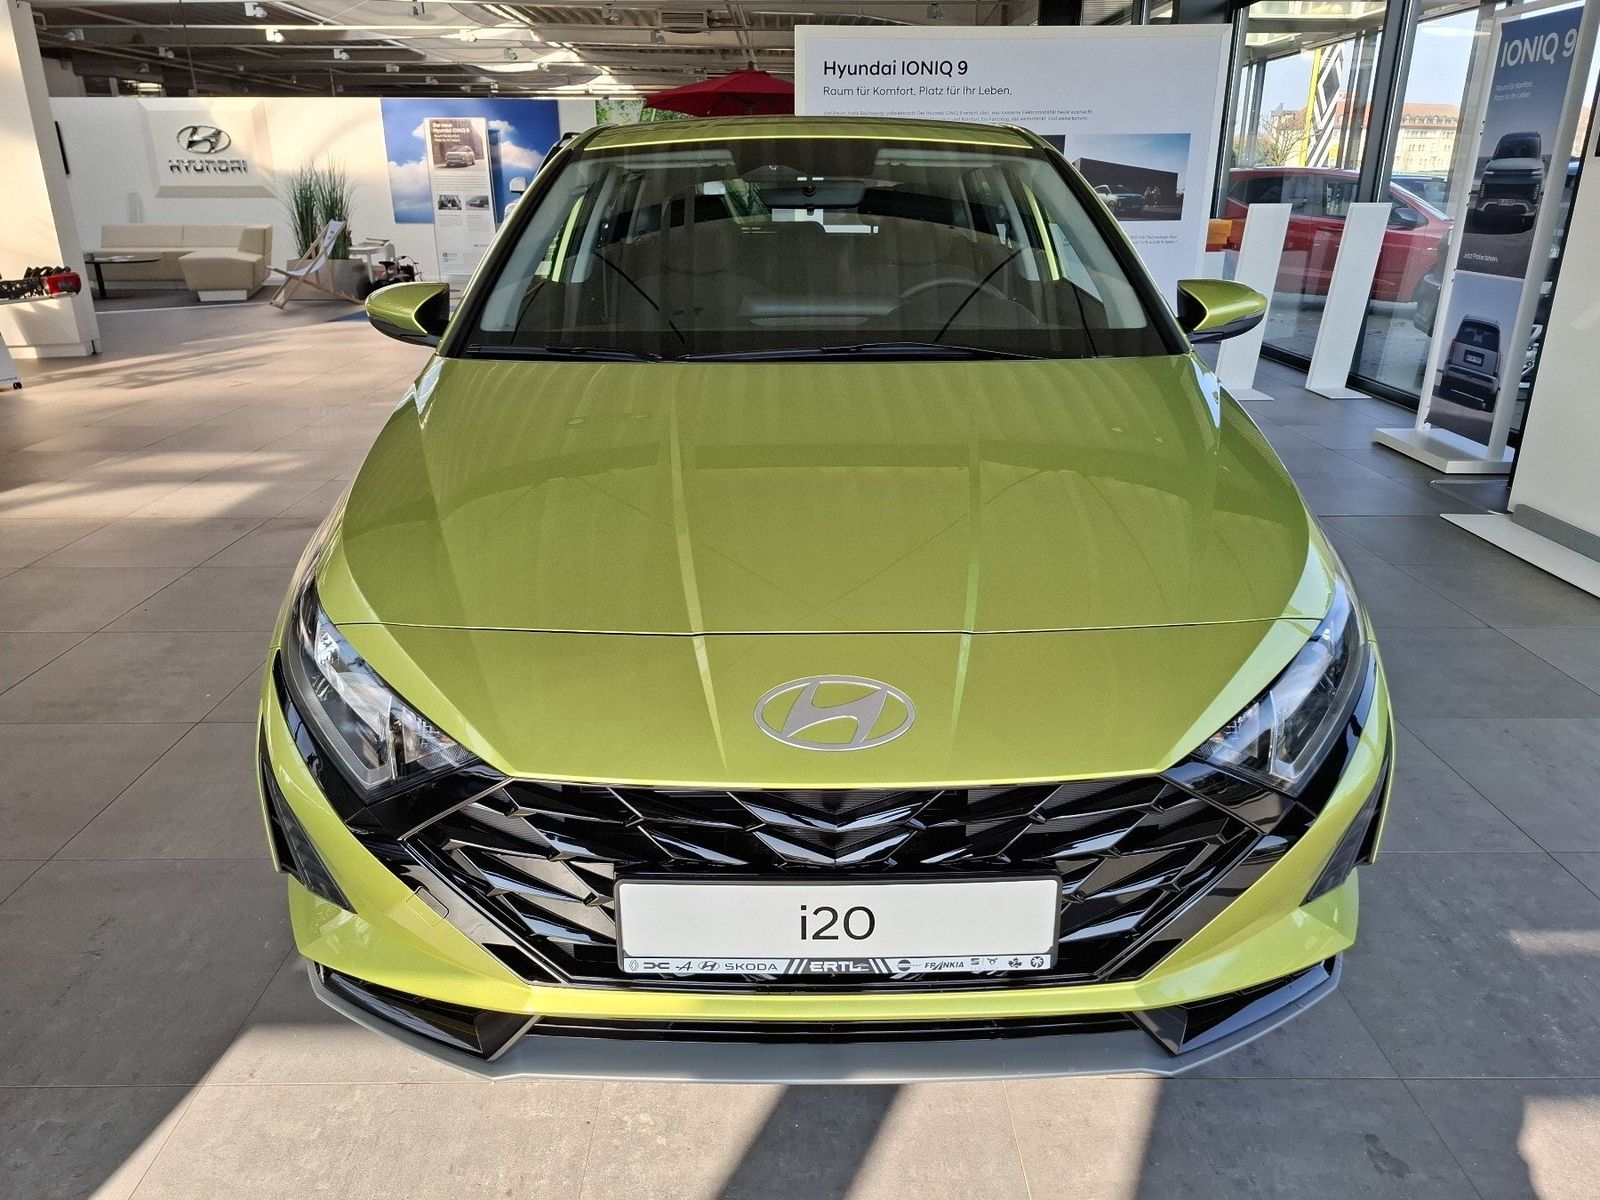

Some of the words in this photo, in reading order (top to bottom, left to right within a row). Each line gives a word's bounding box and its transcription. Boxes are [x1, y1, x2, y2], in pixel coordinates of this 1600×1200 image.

[1500, 32, 1559, 68] IONIQ
[1562, 28, 1577, 58] 9
[823, 60, 896, 79] Hyundai
[901, 60, 954, 78] IONIQ
[957, 60, 968, 76] 9
[823, 86, 854, 96] Raum
[856, 86, 870, 96] für
[873, 86, 916, 96] Komfort.
[919, 86, 943, 96] Platz
[946, 86, 960, 96] für
[962, 86, 976, 96] Ihr
[978, 86, 1012, 96] Leben.
[168, 159, 247, 173] HYUNDAI
[800, 904, 875, 940] i20
[809, 961, 862, 972] ERTL
[924, 961, 964, 971] FRANKIA
